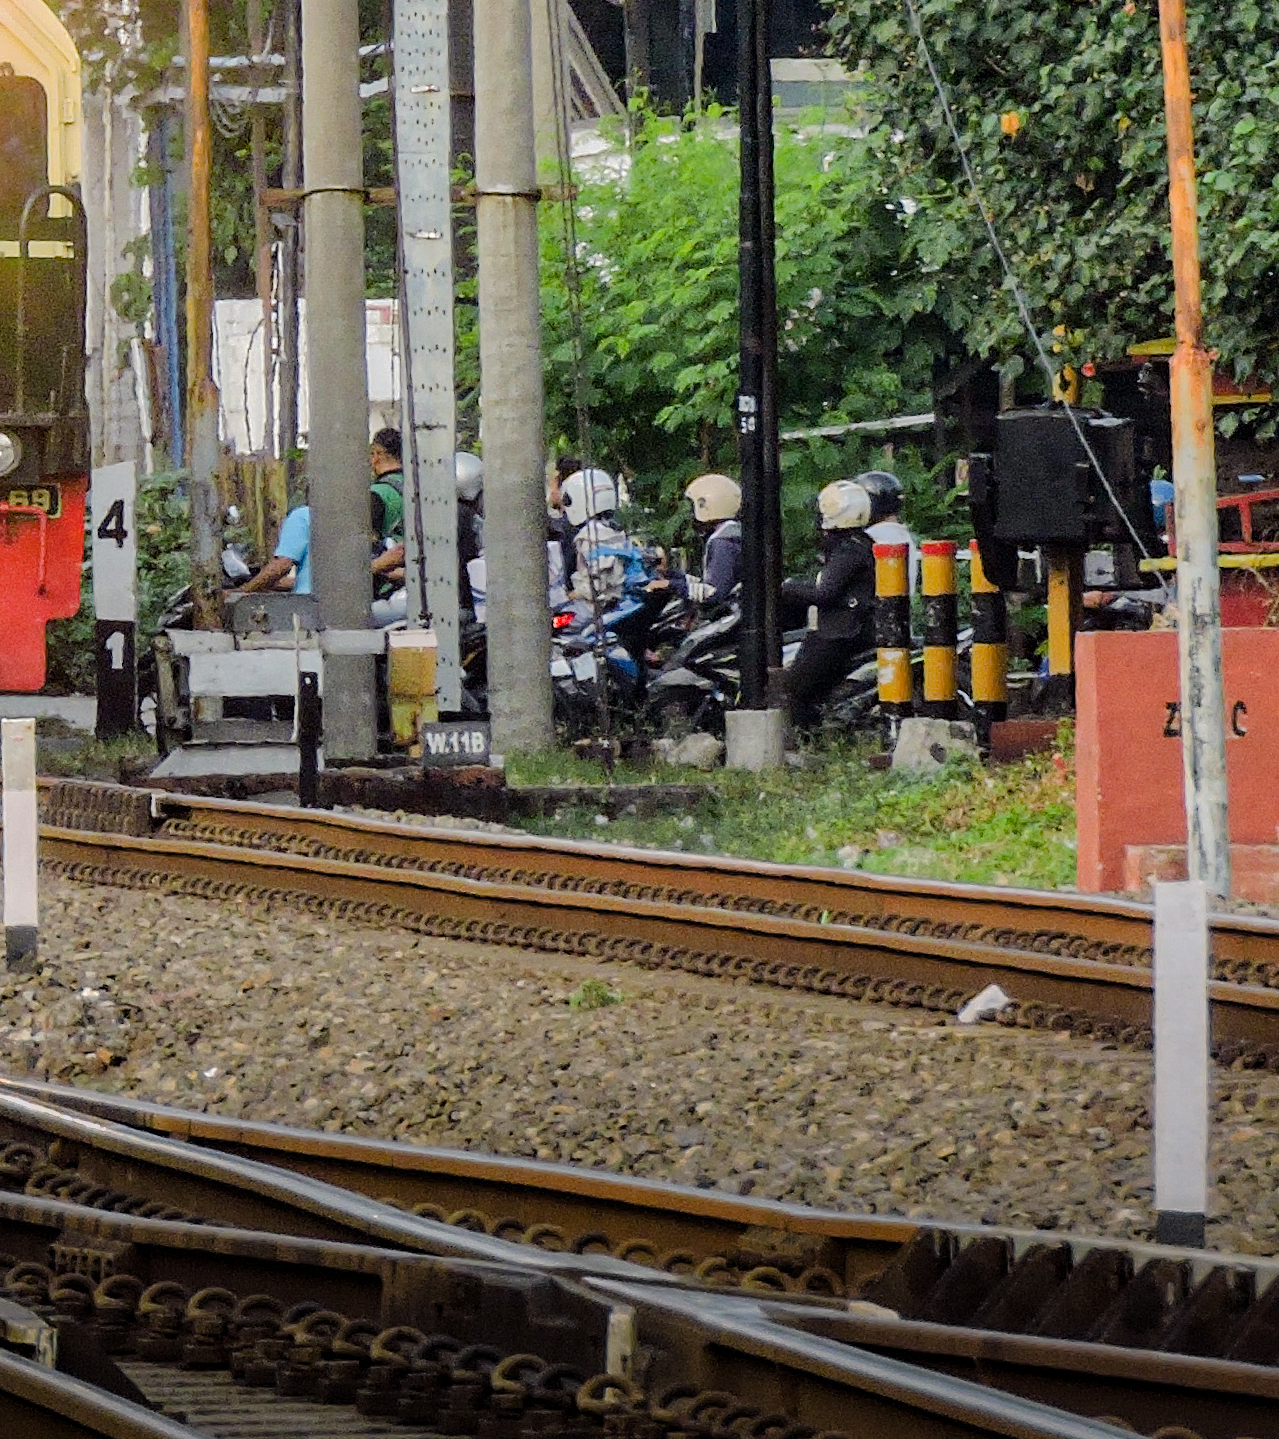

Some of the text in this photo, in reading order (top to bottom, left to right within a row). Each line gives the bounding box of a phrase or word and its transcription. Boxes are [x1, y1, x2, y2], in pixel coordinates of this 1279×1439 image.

[97, 498, 128, 549] 4
[104, 630, 125, 670] 1
[426, 731, 485, 754] W.11B
